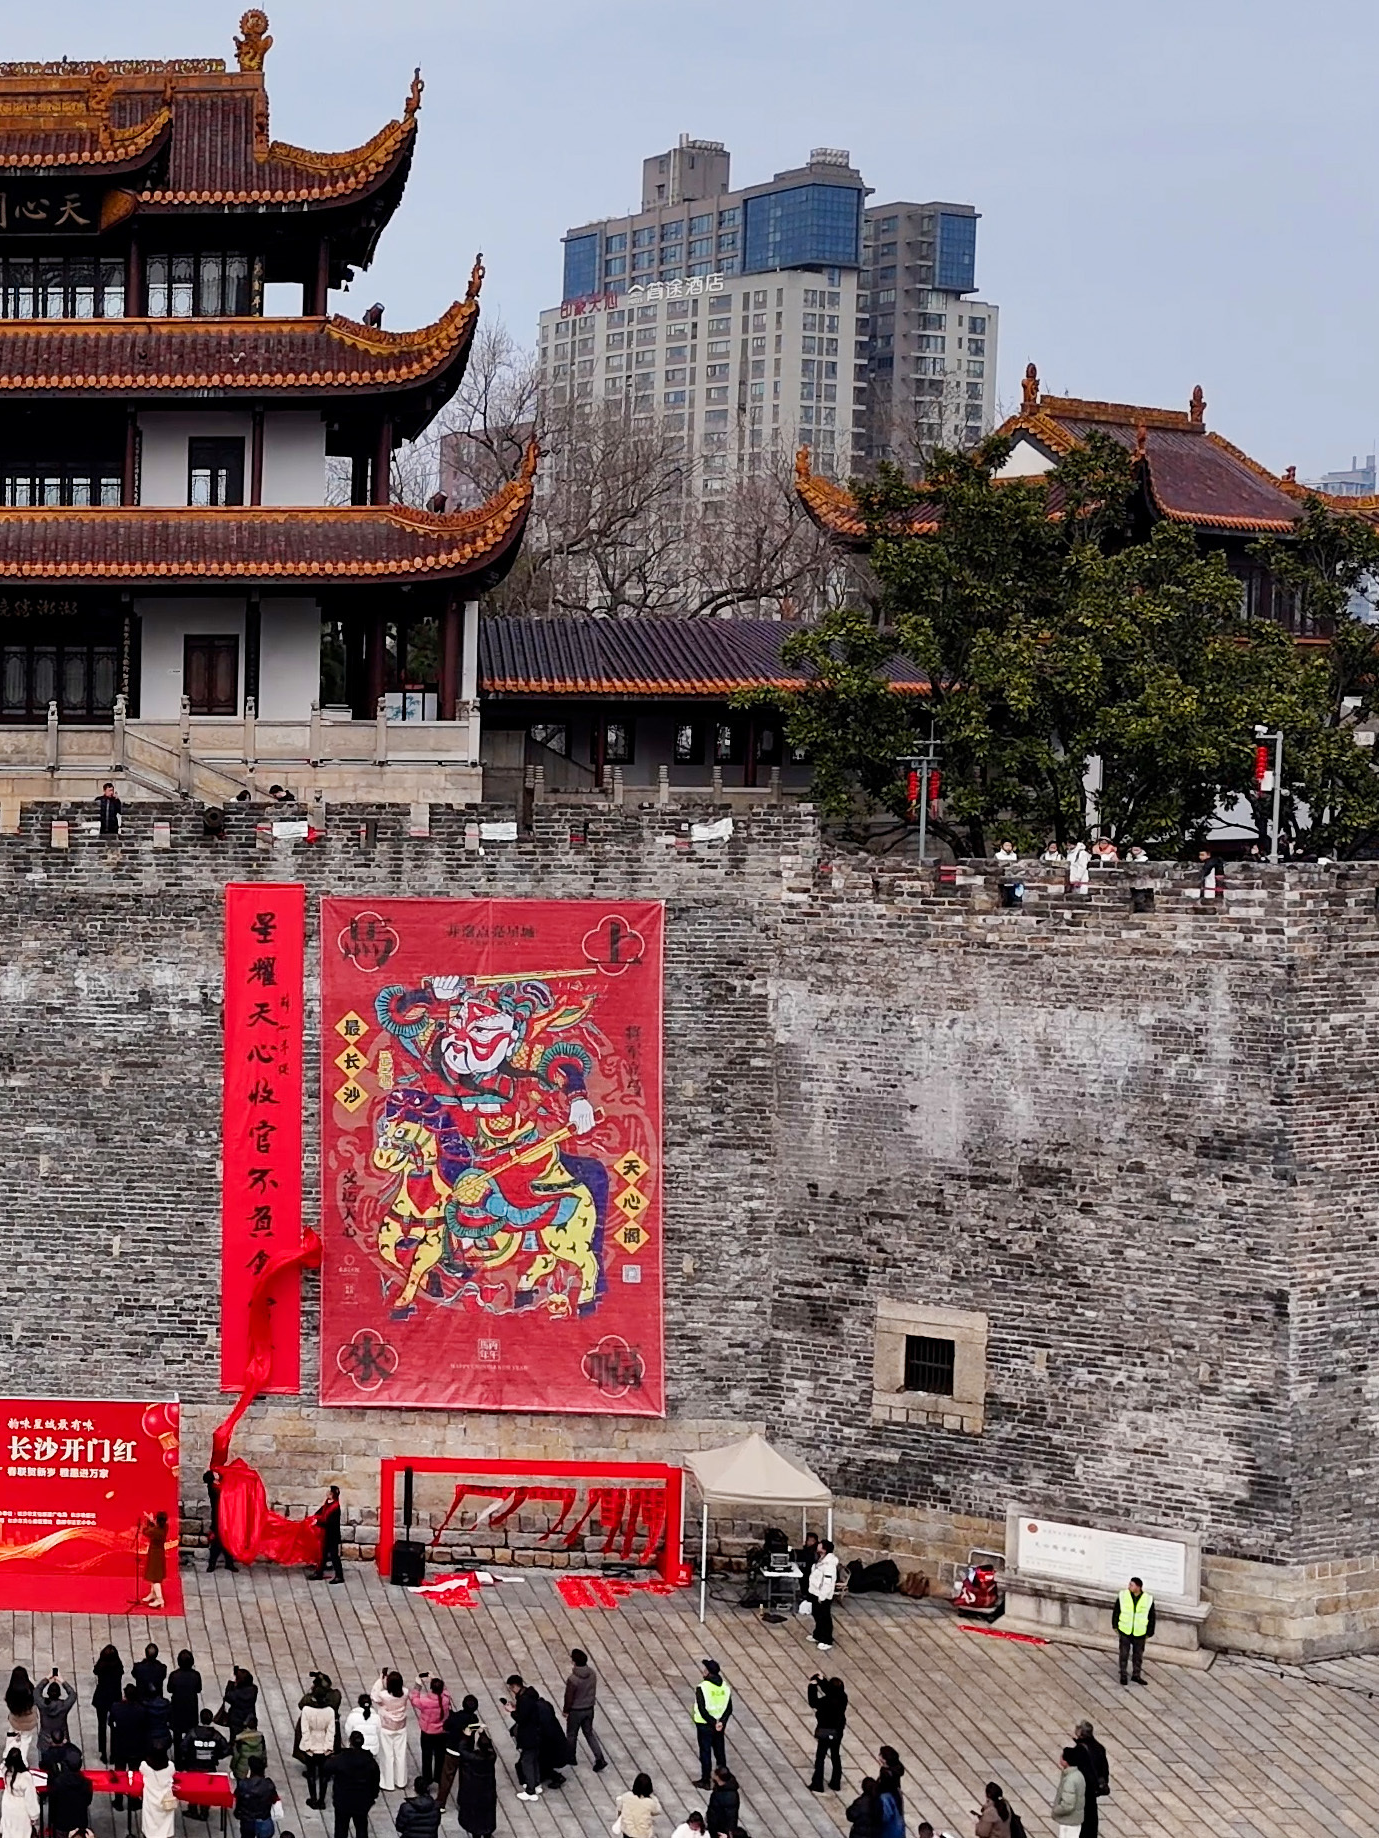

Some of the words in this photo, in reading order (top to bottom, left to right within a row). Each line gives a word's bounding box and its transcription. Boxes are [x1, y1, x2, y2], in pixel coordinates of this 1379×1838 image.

[343, 1019, 361, 1104] 最长沙
[623, 1159, 641, 1244] 天心阁
[7, 1435, 138, 1463] 长沙开门红
